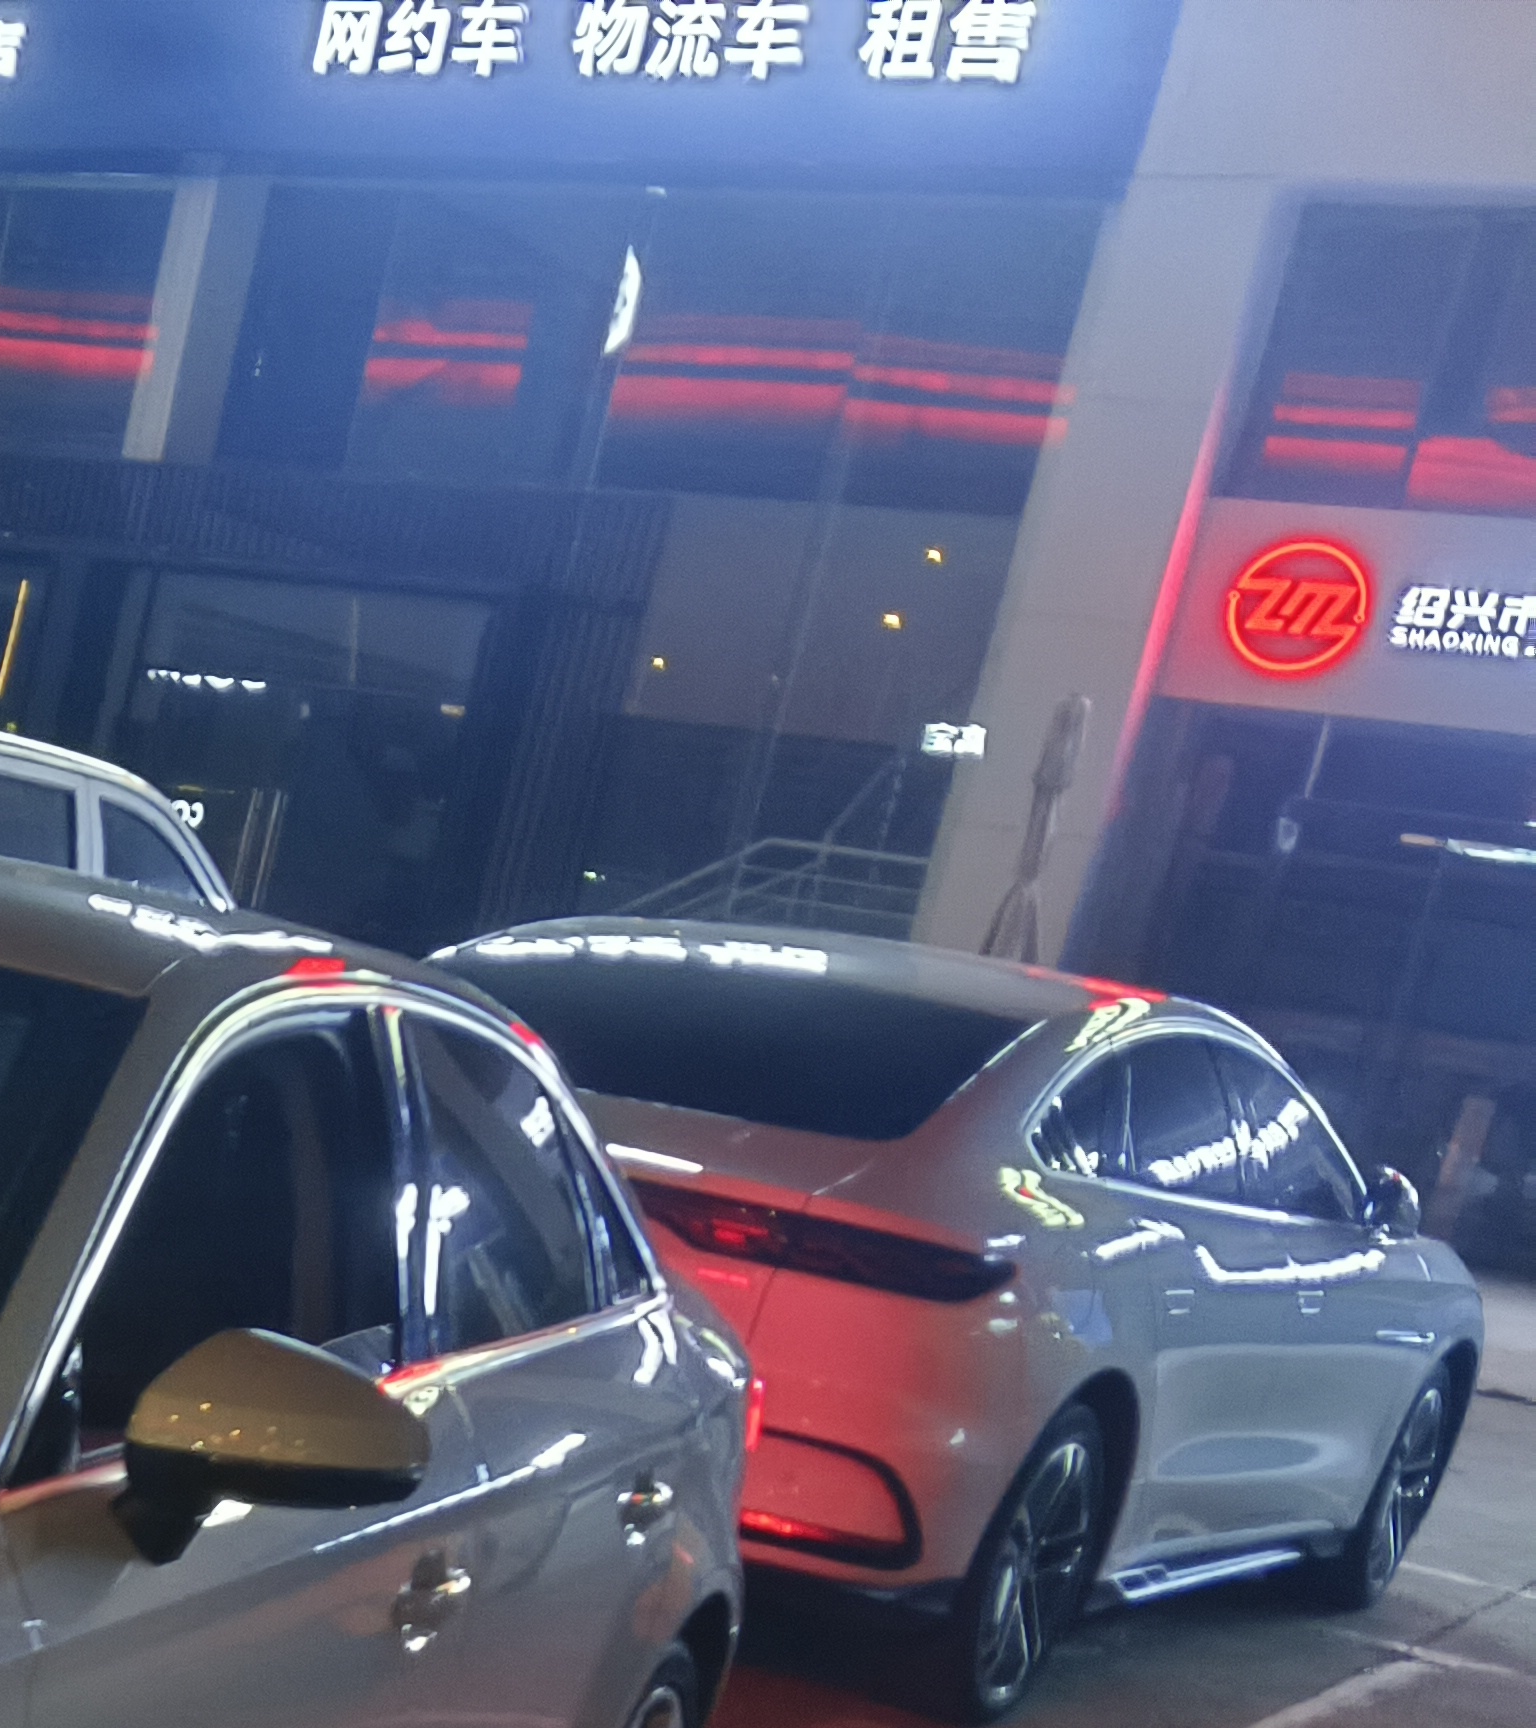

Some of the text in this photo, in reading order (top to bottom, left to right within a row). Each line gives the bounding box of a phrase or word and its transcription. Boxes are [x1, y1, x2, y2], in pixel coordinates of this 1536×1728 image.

[312, 0, 1036, 82] 网约车 物流车 租售
[1388, 625, 1520, 659] SHAOXING
